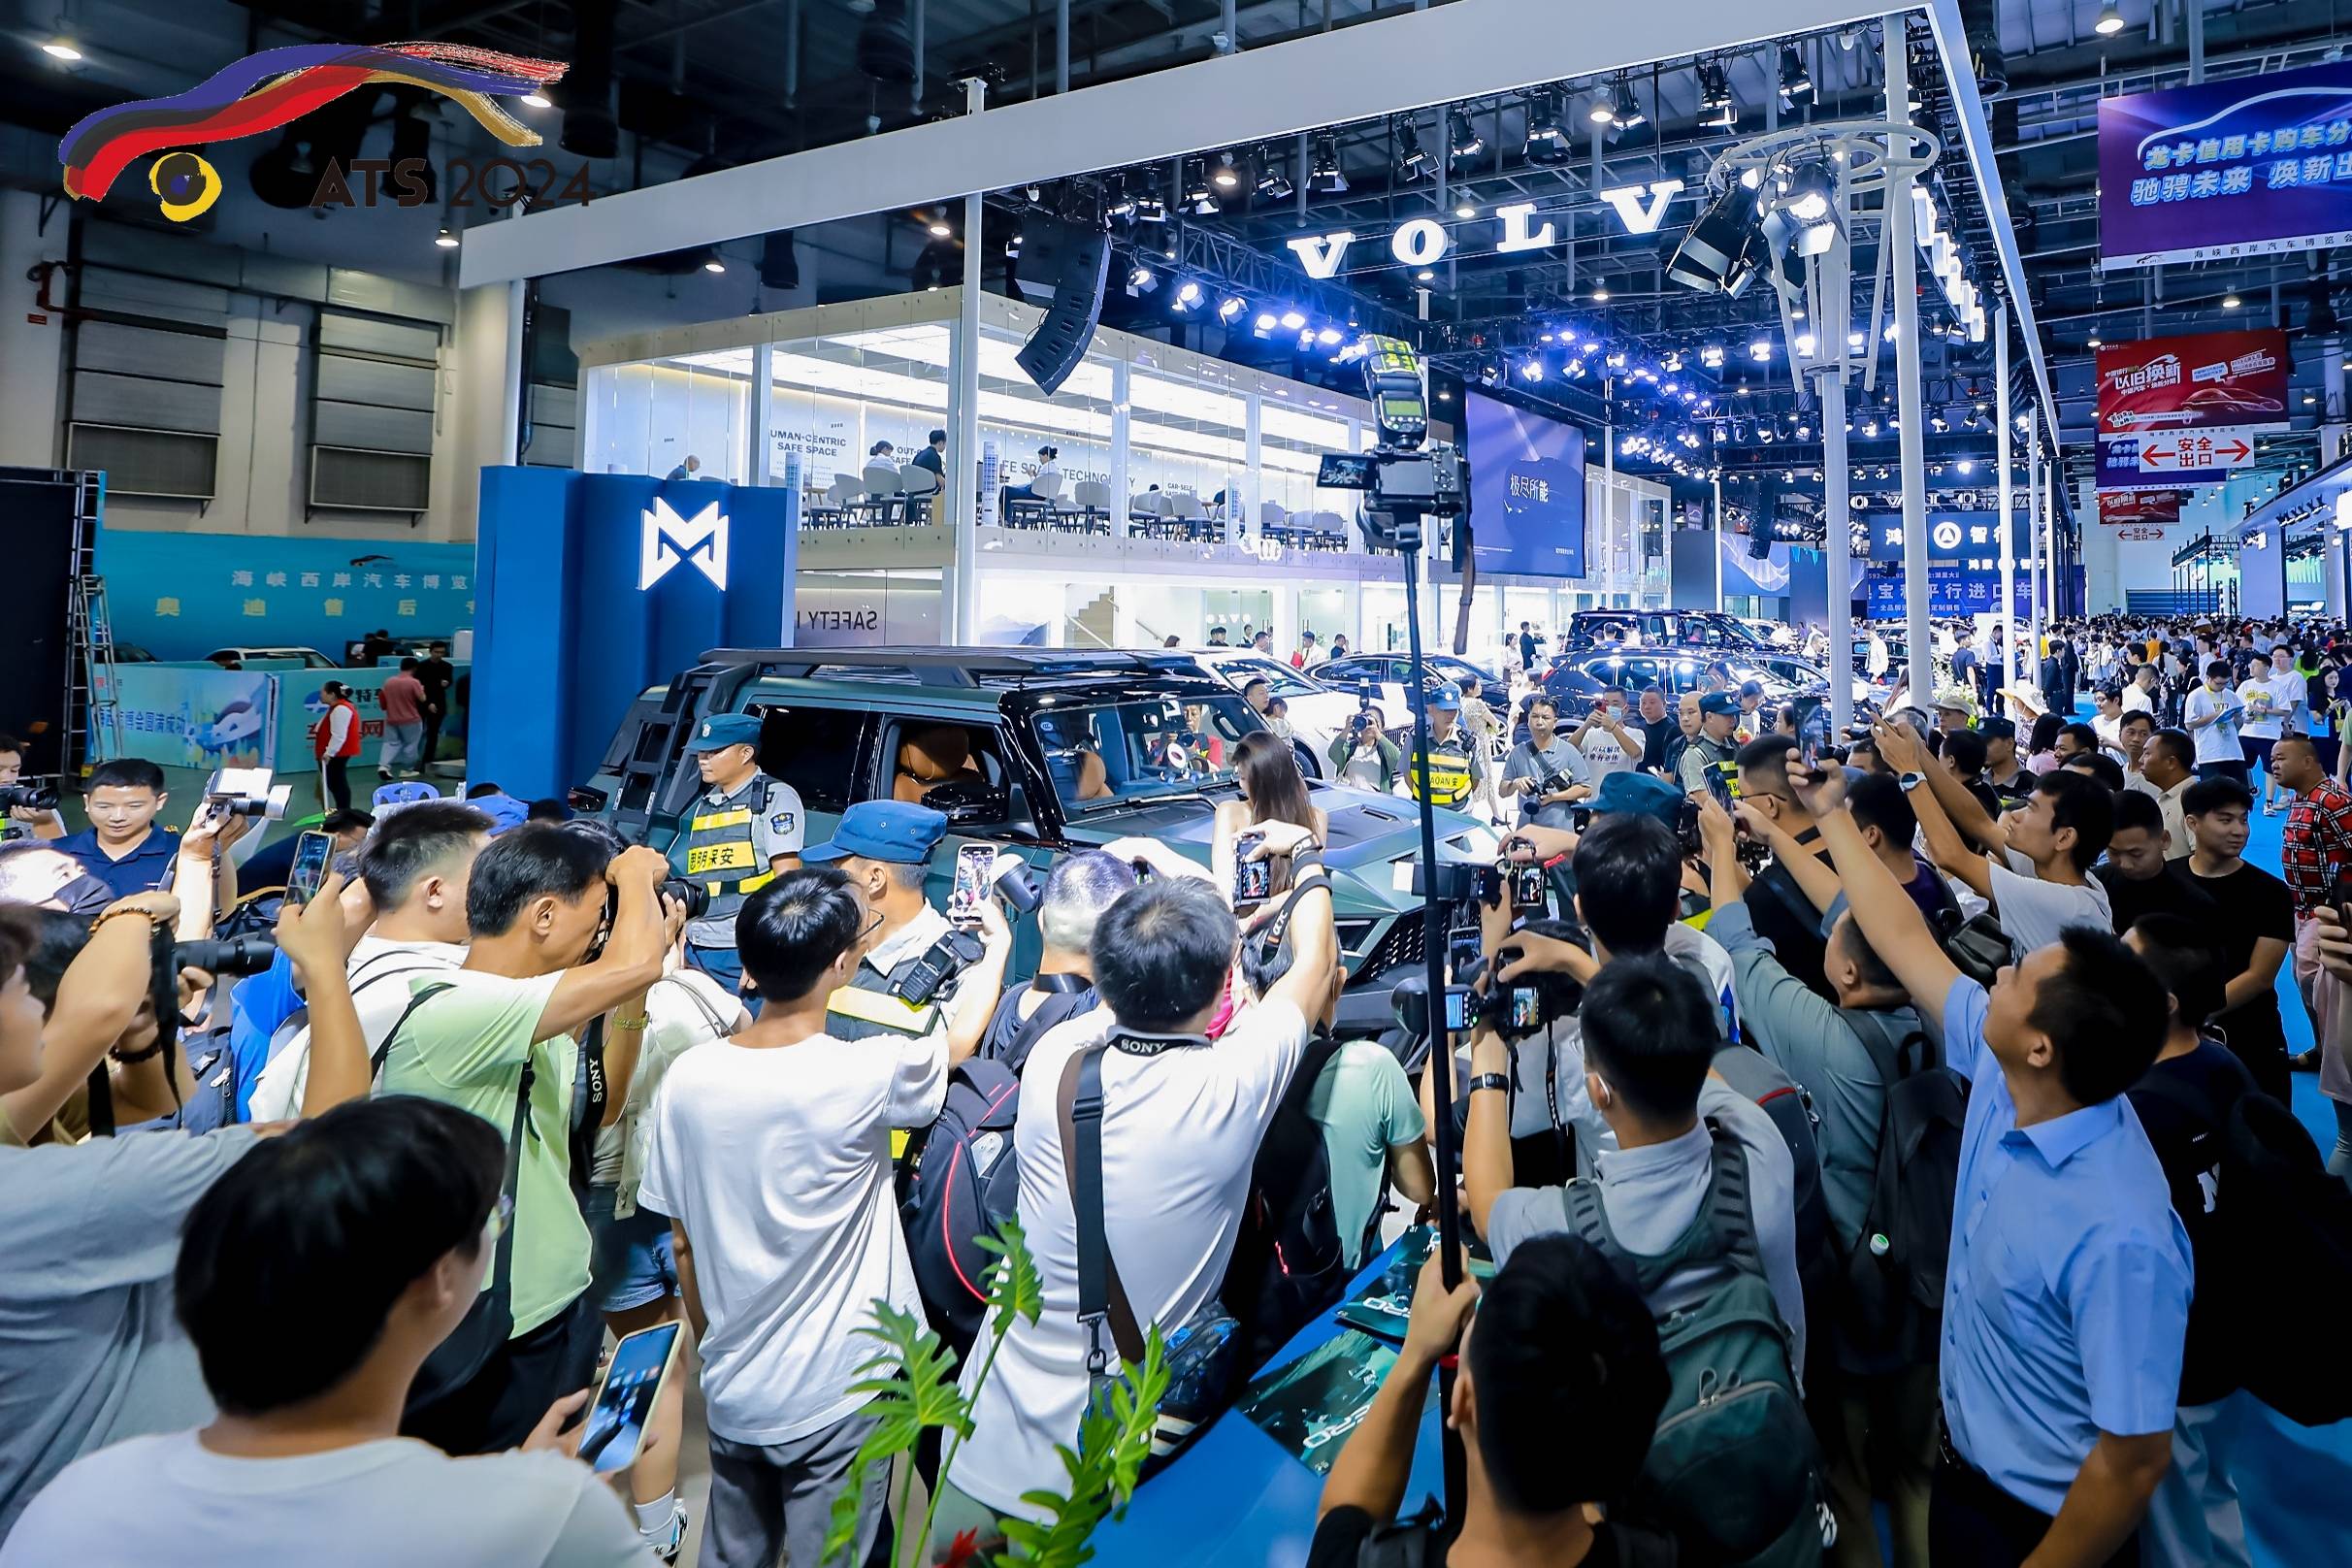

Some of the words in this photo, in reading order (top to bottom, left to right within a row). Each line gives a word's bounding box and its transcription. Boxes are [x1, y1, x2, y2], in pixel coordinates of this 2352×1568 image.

[2131, 166, 2252, 206] 驰骋未来
[1287, 179, 1685, 279] VOLV
[777, 441, 803, 453] SAFE
[805, 445, 837, 457] SPACE
[2177, 437, 2212, 452] 安全
[2178, 452, 2212, 468] 出口
[1510, 474, 1551, 503] 极尽所能
[1121, 1038, 1167, 1054] SONY
[589, 1058, 603, 1103] SONY
